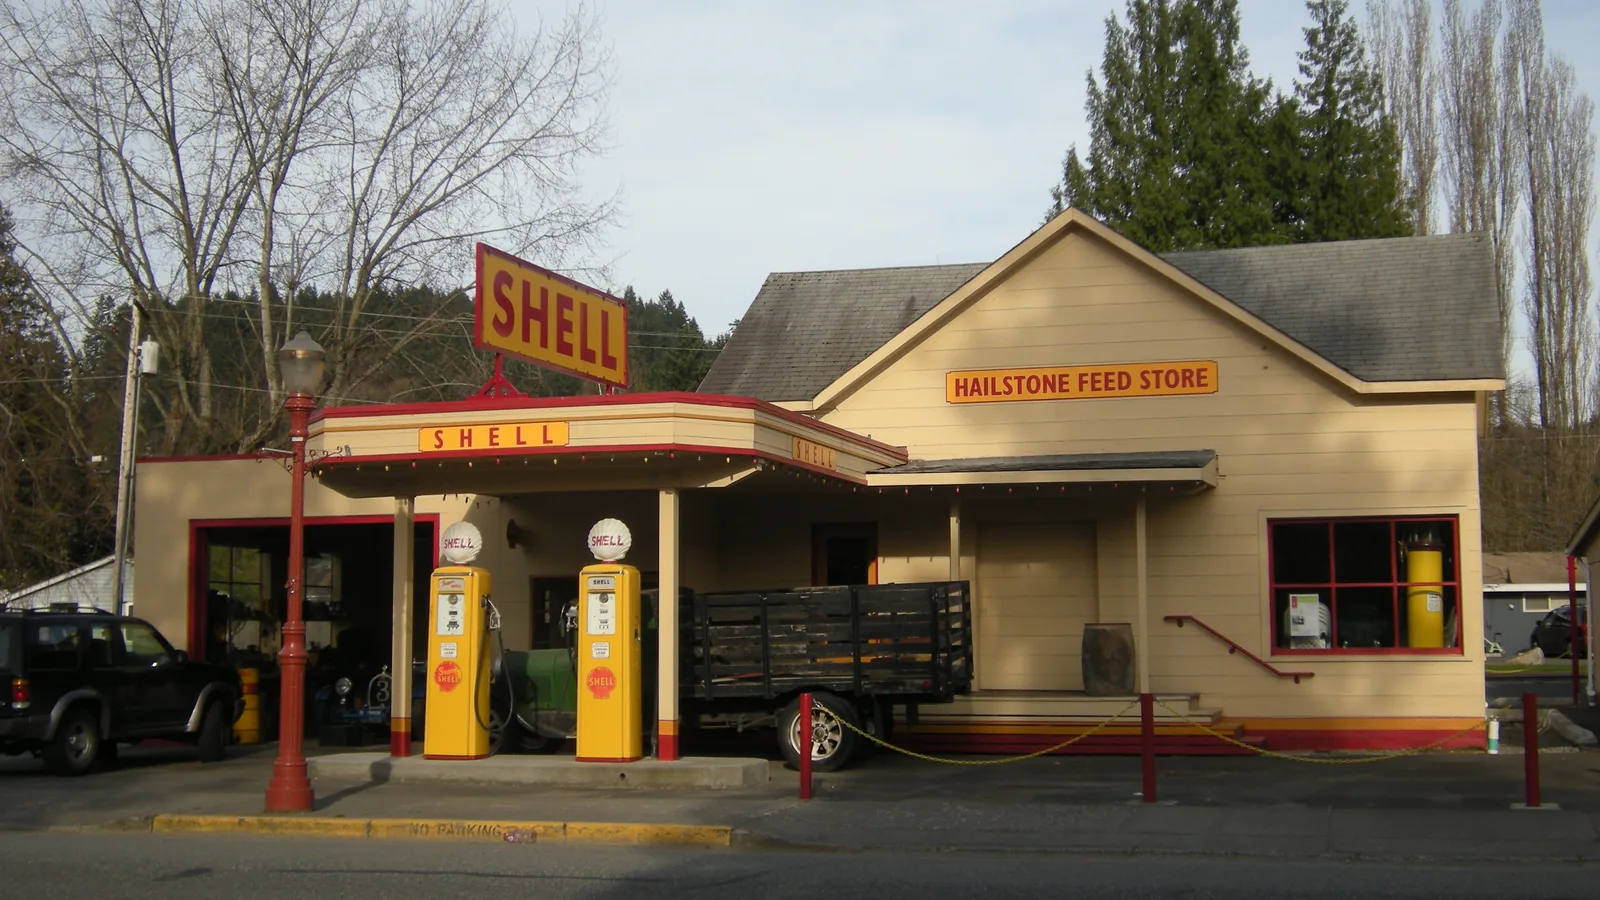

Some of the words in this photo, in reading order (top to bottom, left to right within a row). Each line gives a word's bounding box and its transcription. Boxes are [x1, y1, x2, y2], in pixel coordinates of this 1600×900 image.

[492, 270, 617, 371] SHELL
[954, 374, 1070, 397] HAILSTONE
[1078, 371, 1132, 393] FEED
[1139, 367, 1209, 390] STORE
[433, 424, 554, 450] SHELL
[796, 440, 833, 469] SHELL
[443, 538, 475, 549] SHELL
[591, 535, 624, 547] SHELL
[437, 675, 459, 683] SHELL
[588, 676, 614, 687] SHELL
[376, 680, 389, 702] 3
[409, 822, 430, 836] NO
[437, 822, 502, 838] PARKING
